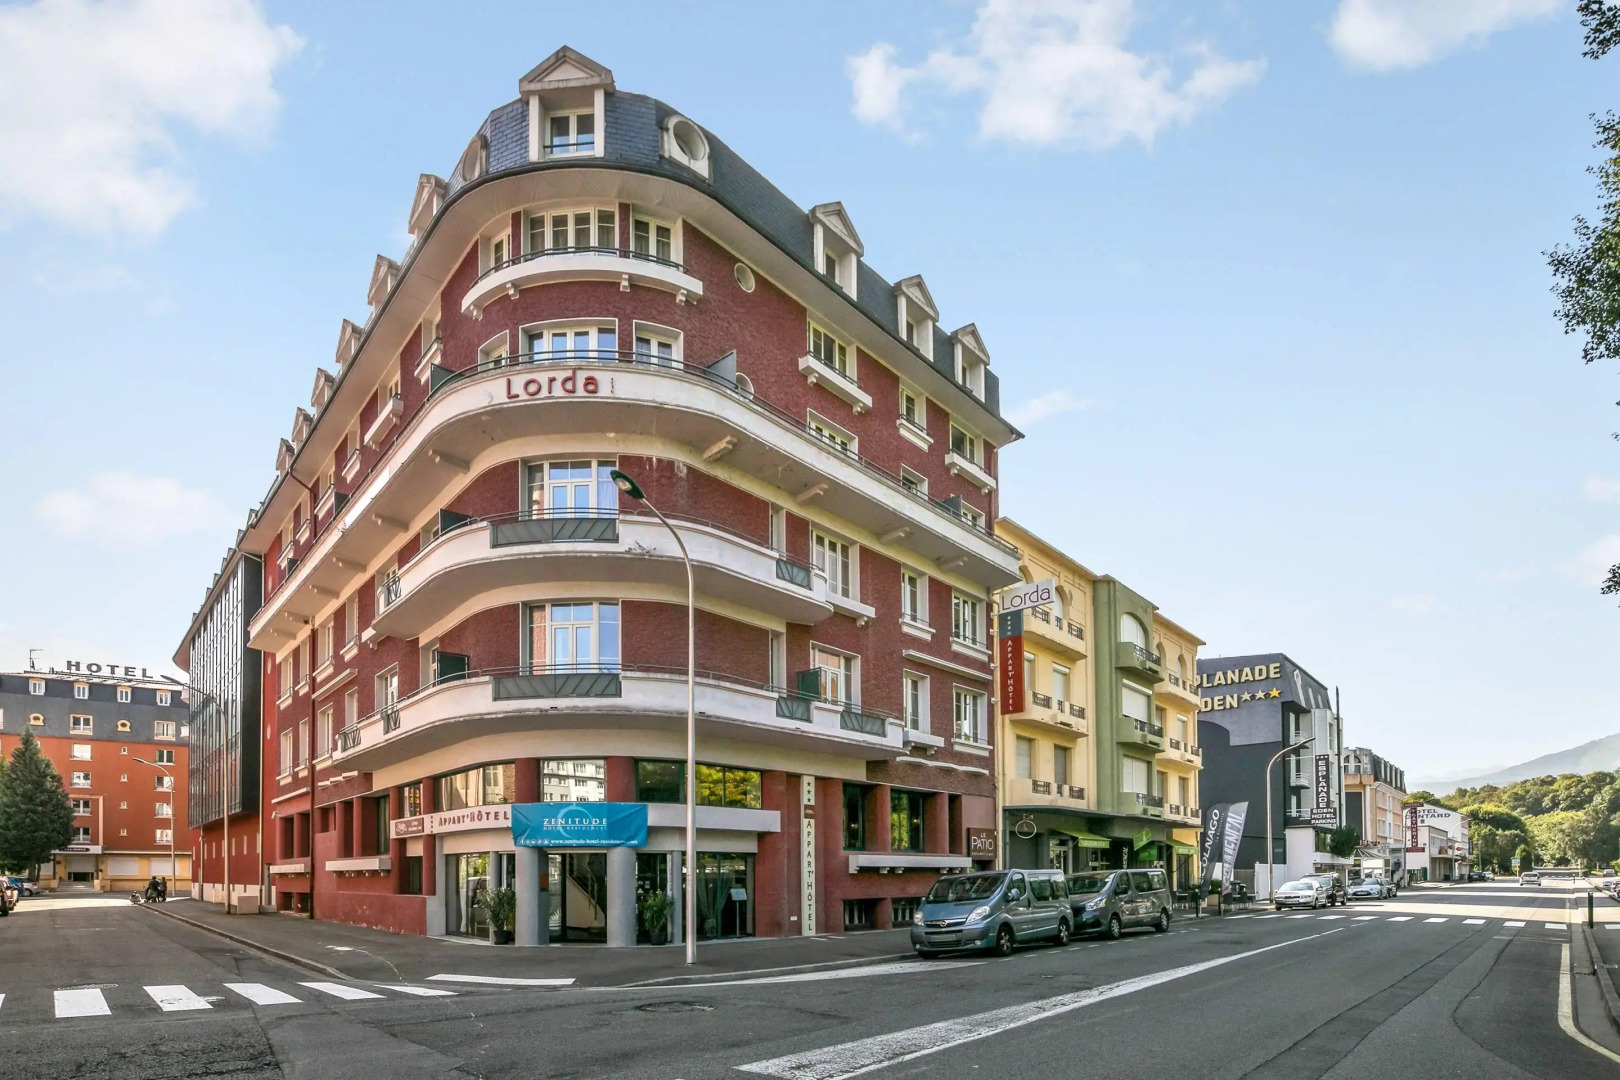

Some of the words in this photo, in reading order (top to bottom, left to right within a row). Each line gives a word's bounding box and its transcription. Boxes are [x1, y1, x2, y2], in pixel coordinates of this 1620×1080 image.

[506, 366, 598, 400] Lorda
[1002, 584, 1050, 610] Lorda
[66, 660, 153, 678] HOTEL
[1318, 760, 1327, 808] ESPLANADE
[972, 836, 994, 850] PATIO
